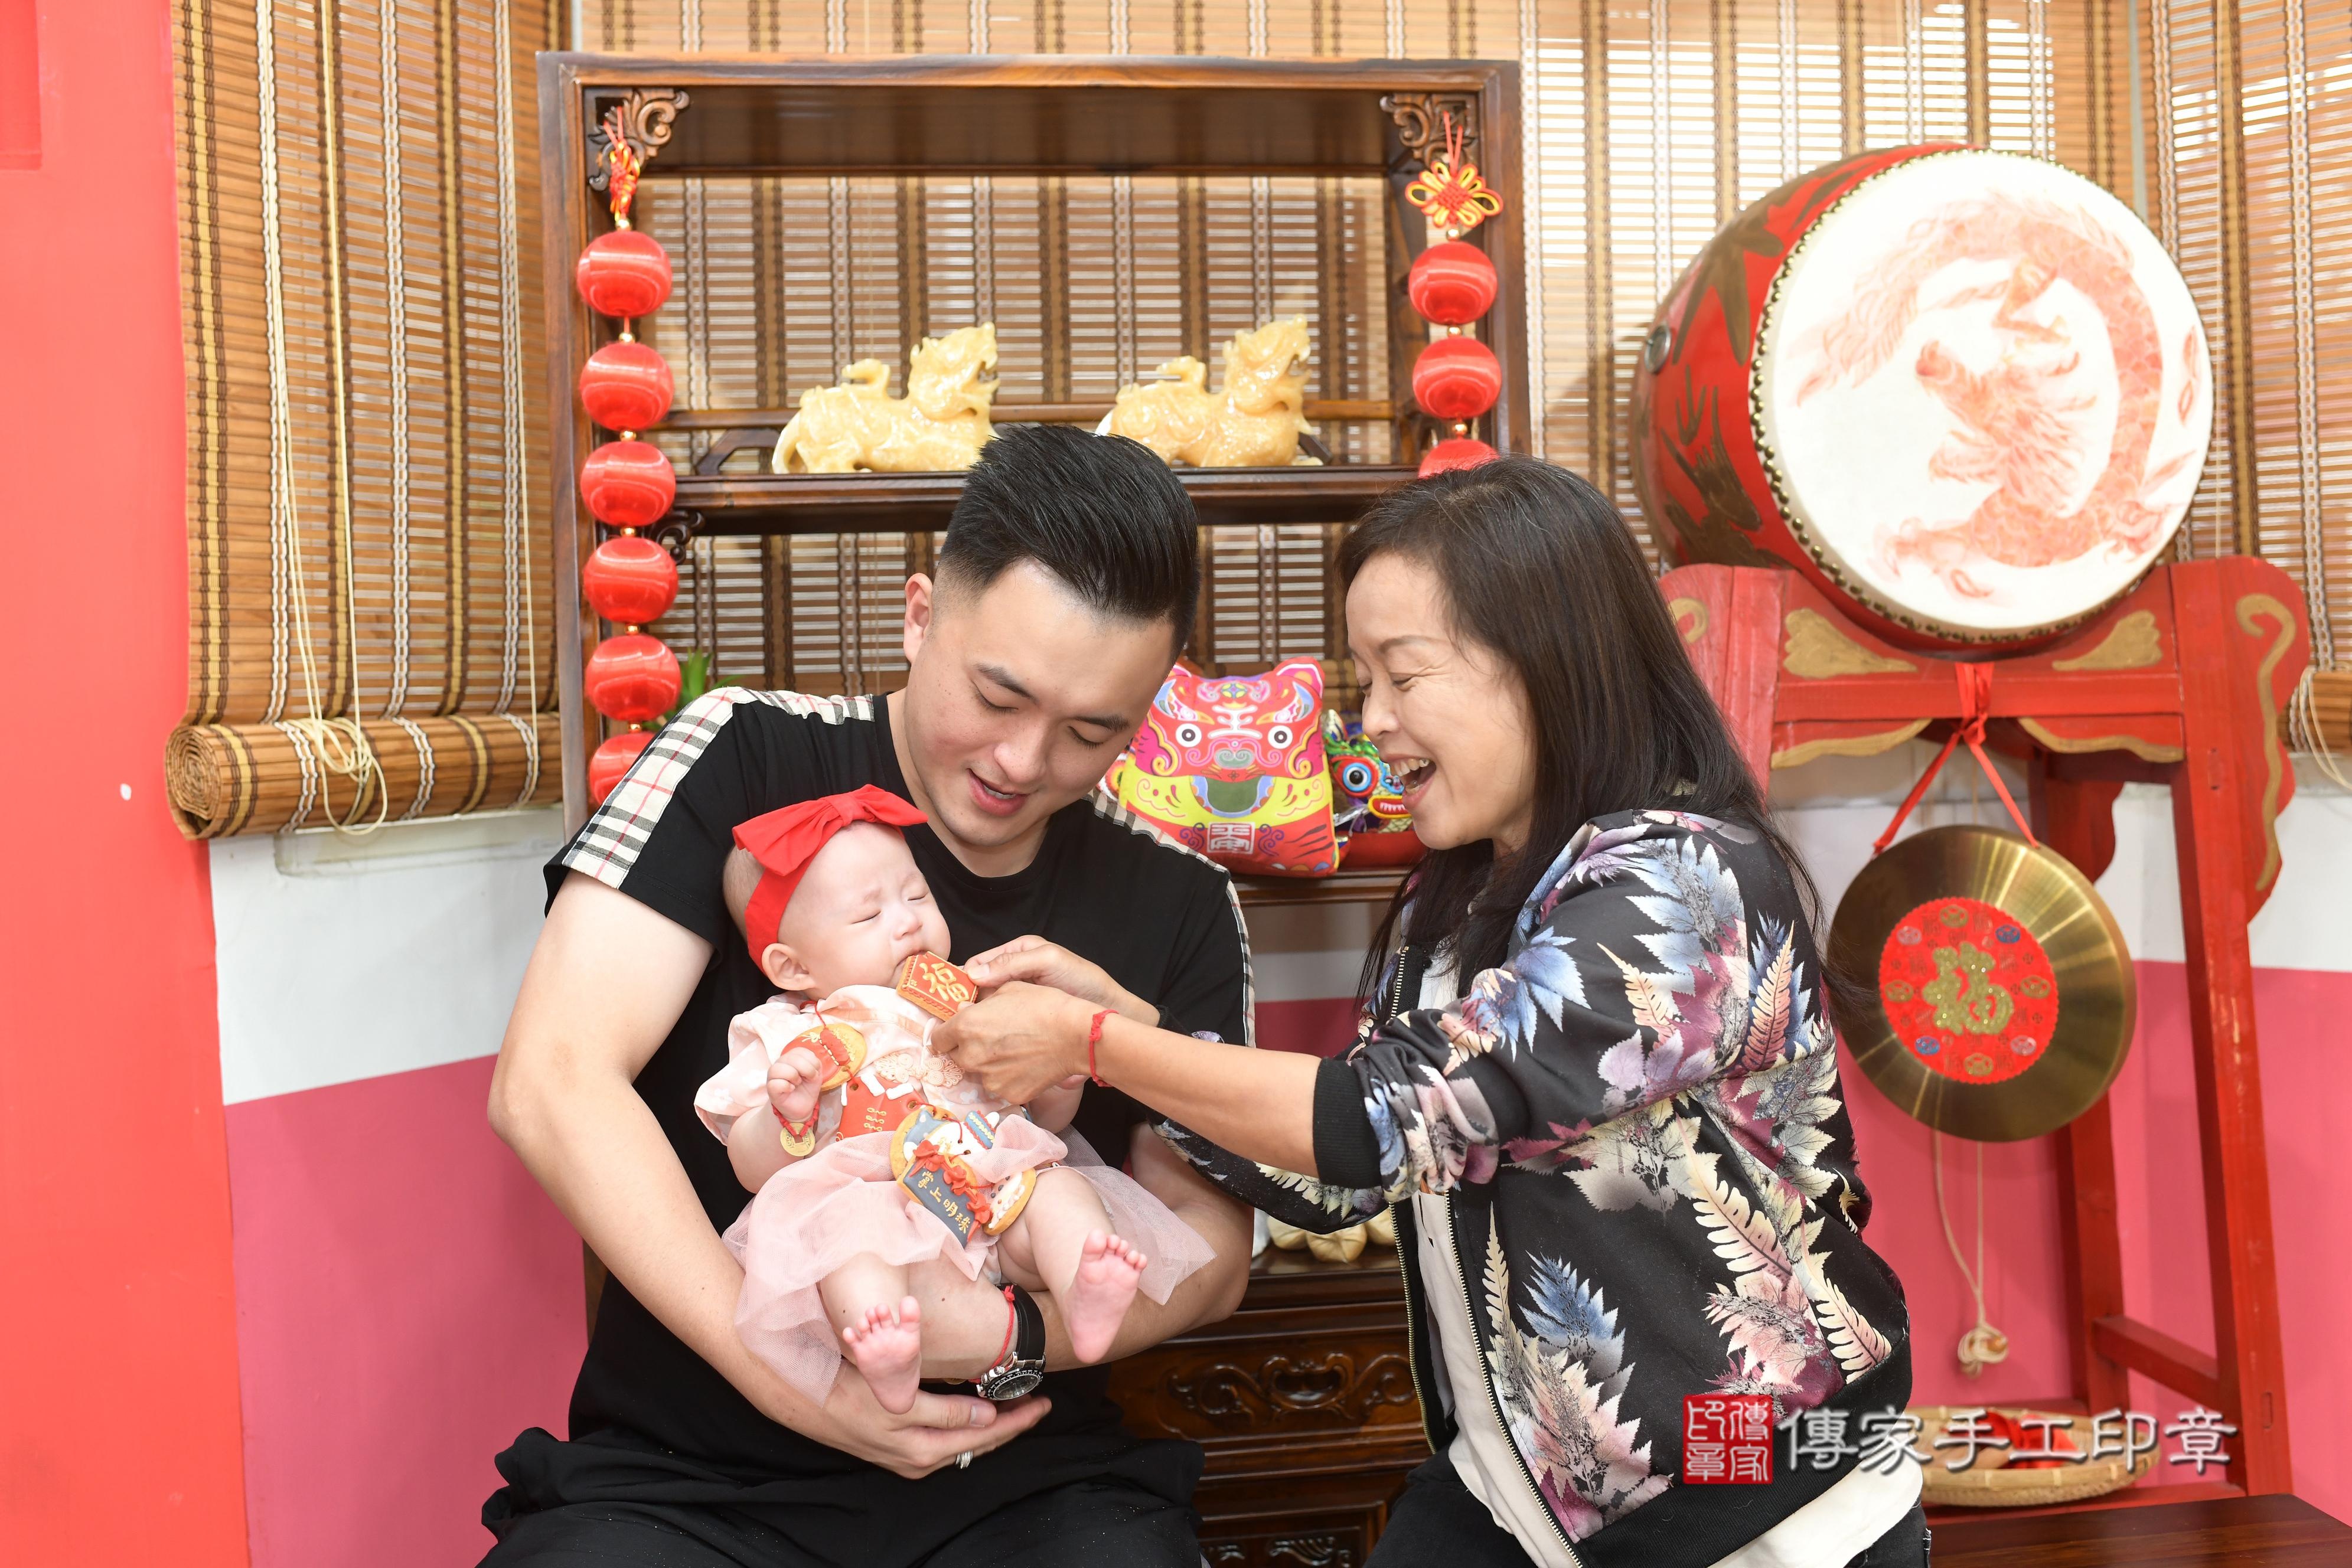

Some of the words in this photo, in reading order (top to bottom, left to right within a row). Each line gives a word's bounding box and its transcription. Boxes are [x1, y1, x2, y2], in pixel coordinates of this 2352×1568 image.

[919, 962, 969, 1002] 福
[1923, 942, 2014, 1034] 福
[918, 1171, 970, 1234] 掌上明珠
